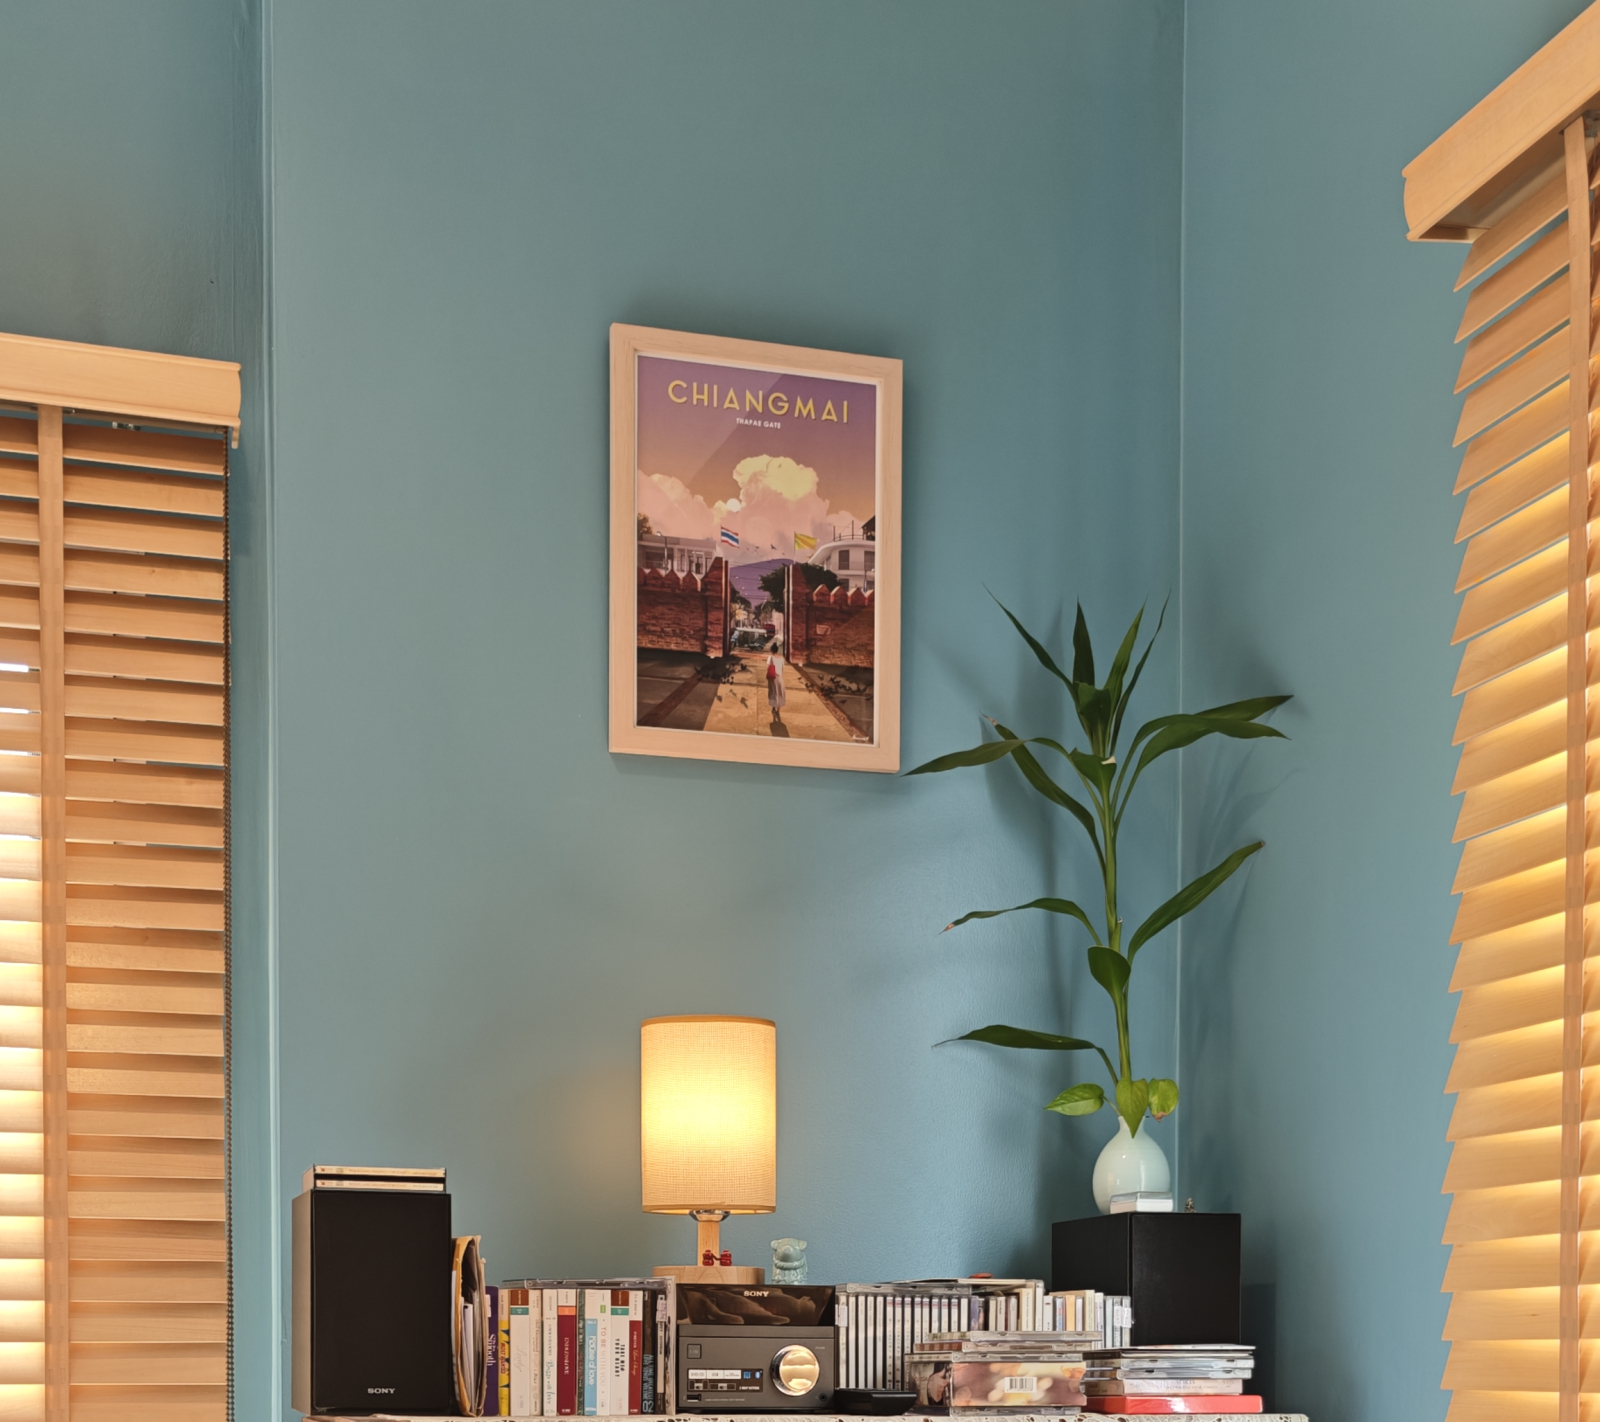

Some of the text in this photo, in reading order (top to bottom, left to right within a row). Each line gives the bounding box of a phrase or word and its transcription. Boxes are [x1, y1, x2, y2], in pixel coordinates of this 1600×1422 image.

[667, 380, 849, 424] CHIANGMAI
[736, 417, 782, 430] THAPAE GATE
[743, 1290, 770, 1298] SONY
[600, 1327, 606, 1337] TO
[600, 1339, 606, 1348] BE
[588, 1369, 597, 1386] love
[367, 1387, 396, 1395] SONY
[642, 1400, 654, 1413] 02
